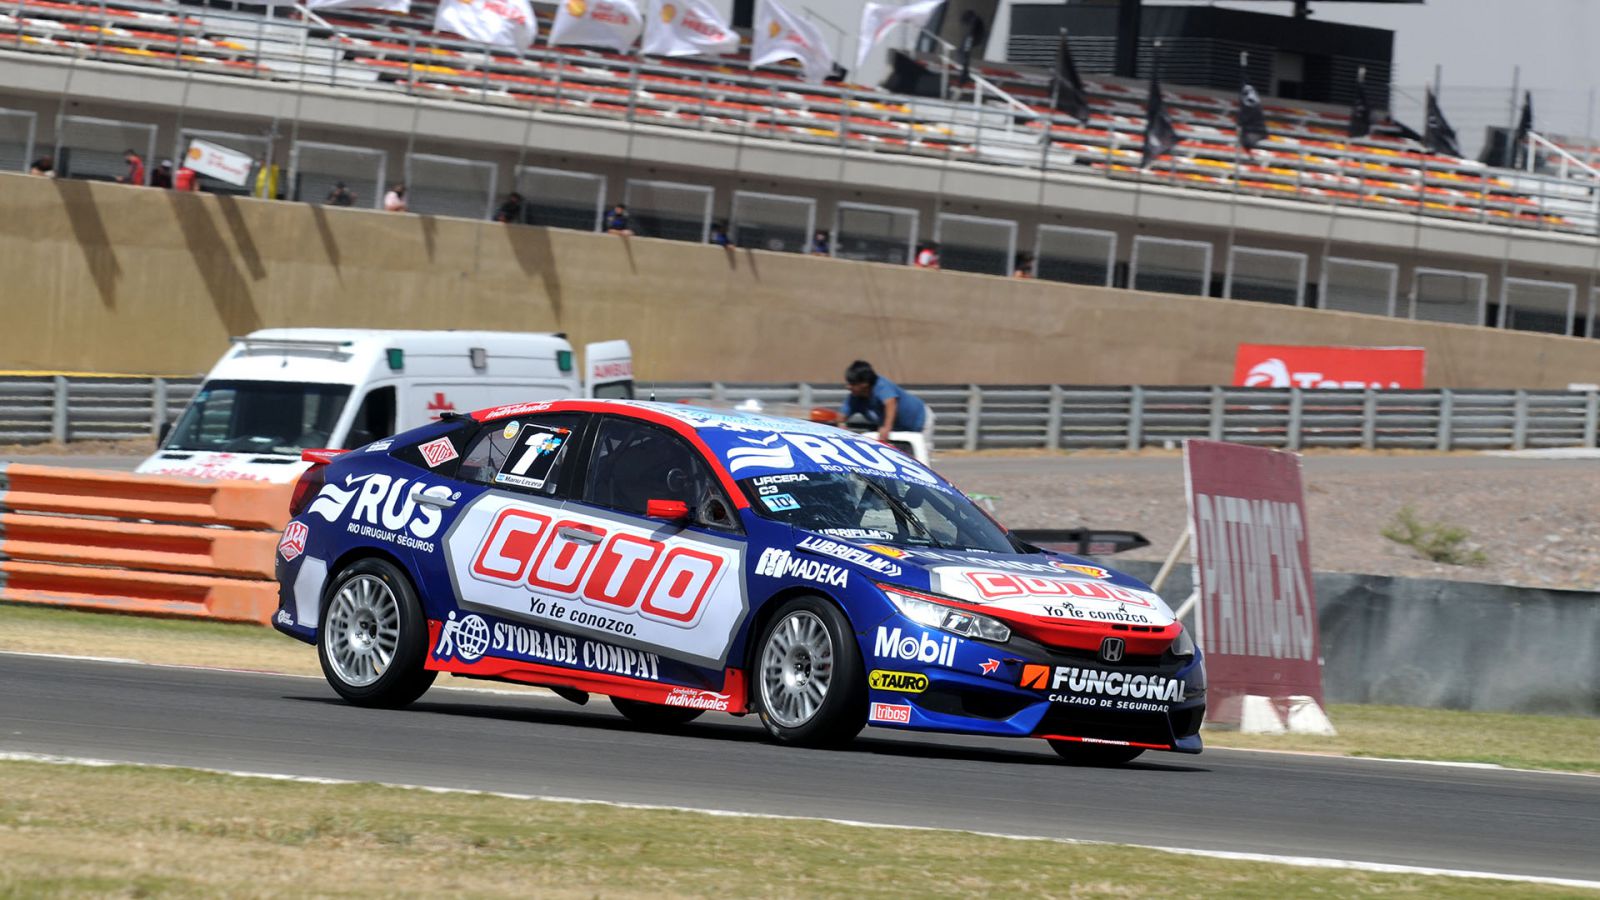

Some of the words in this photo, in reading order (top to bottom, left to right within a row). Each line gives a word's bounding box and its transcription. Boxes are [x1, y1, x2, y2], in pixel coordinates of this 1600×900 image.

[510, 432, 554, 475] 1
[782, 433, 938, 484] RUS
[820, 464, 843, 473] RIO
[753, 473, 810, 486] URCERA
[758, 485, 779, 495] C3
[351, 473, 453, 539] RUS
[347, 522, 360, 533] RIO
[360, 526, 397, 543] URUGUAY
[396, 535, 435, 553] SEGUROS
[796, 535, 889, 572] LUBRIFILM
[473, 508, 724, 623] COTO
[785, 557, 849, 588] MADEKA
[964, 571, 1151, 607] COTO
[529, 597, 546, 614] Yo
[550, 599, 564, 619] te
[569, 609, 637, 636] conozco.
[1043, 605, 1063, 618] Yo
[1068, 606, 1085, 618] te
[1088, 609, 1153, 624] conozco.
[492, 622, 578, 665] STORAGE
[583, 640, 660, 680] COMPAT
[874, 626, 957, 667] Mobil
[881, 673, 927, 690] TAURO
[1052, 666, 1187, 703] FUNCIONAL
[665, 692, 729, 711] individuales
[877, 704, 908, 722] tribos
[1048, 694, 1097, 706] CALZADO
[1100, 699, 1112, 708] DE
[1116, 701, 1170, 713] SEGURIDAD
